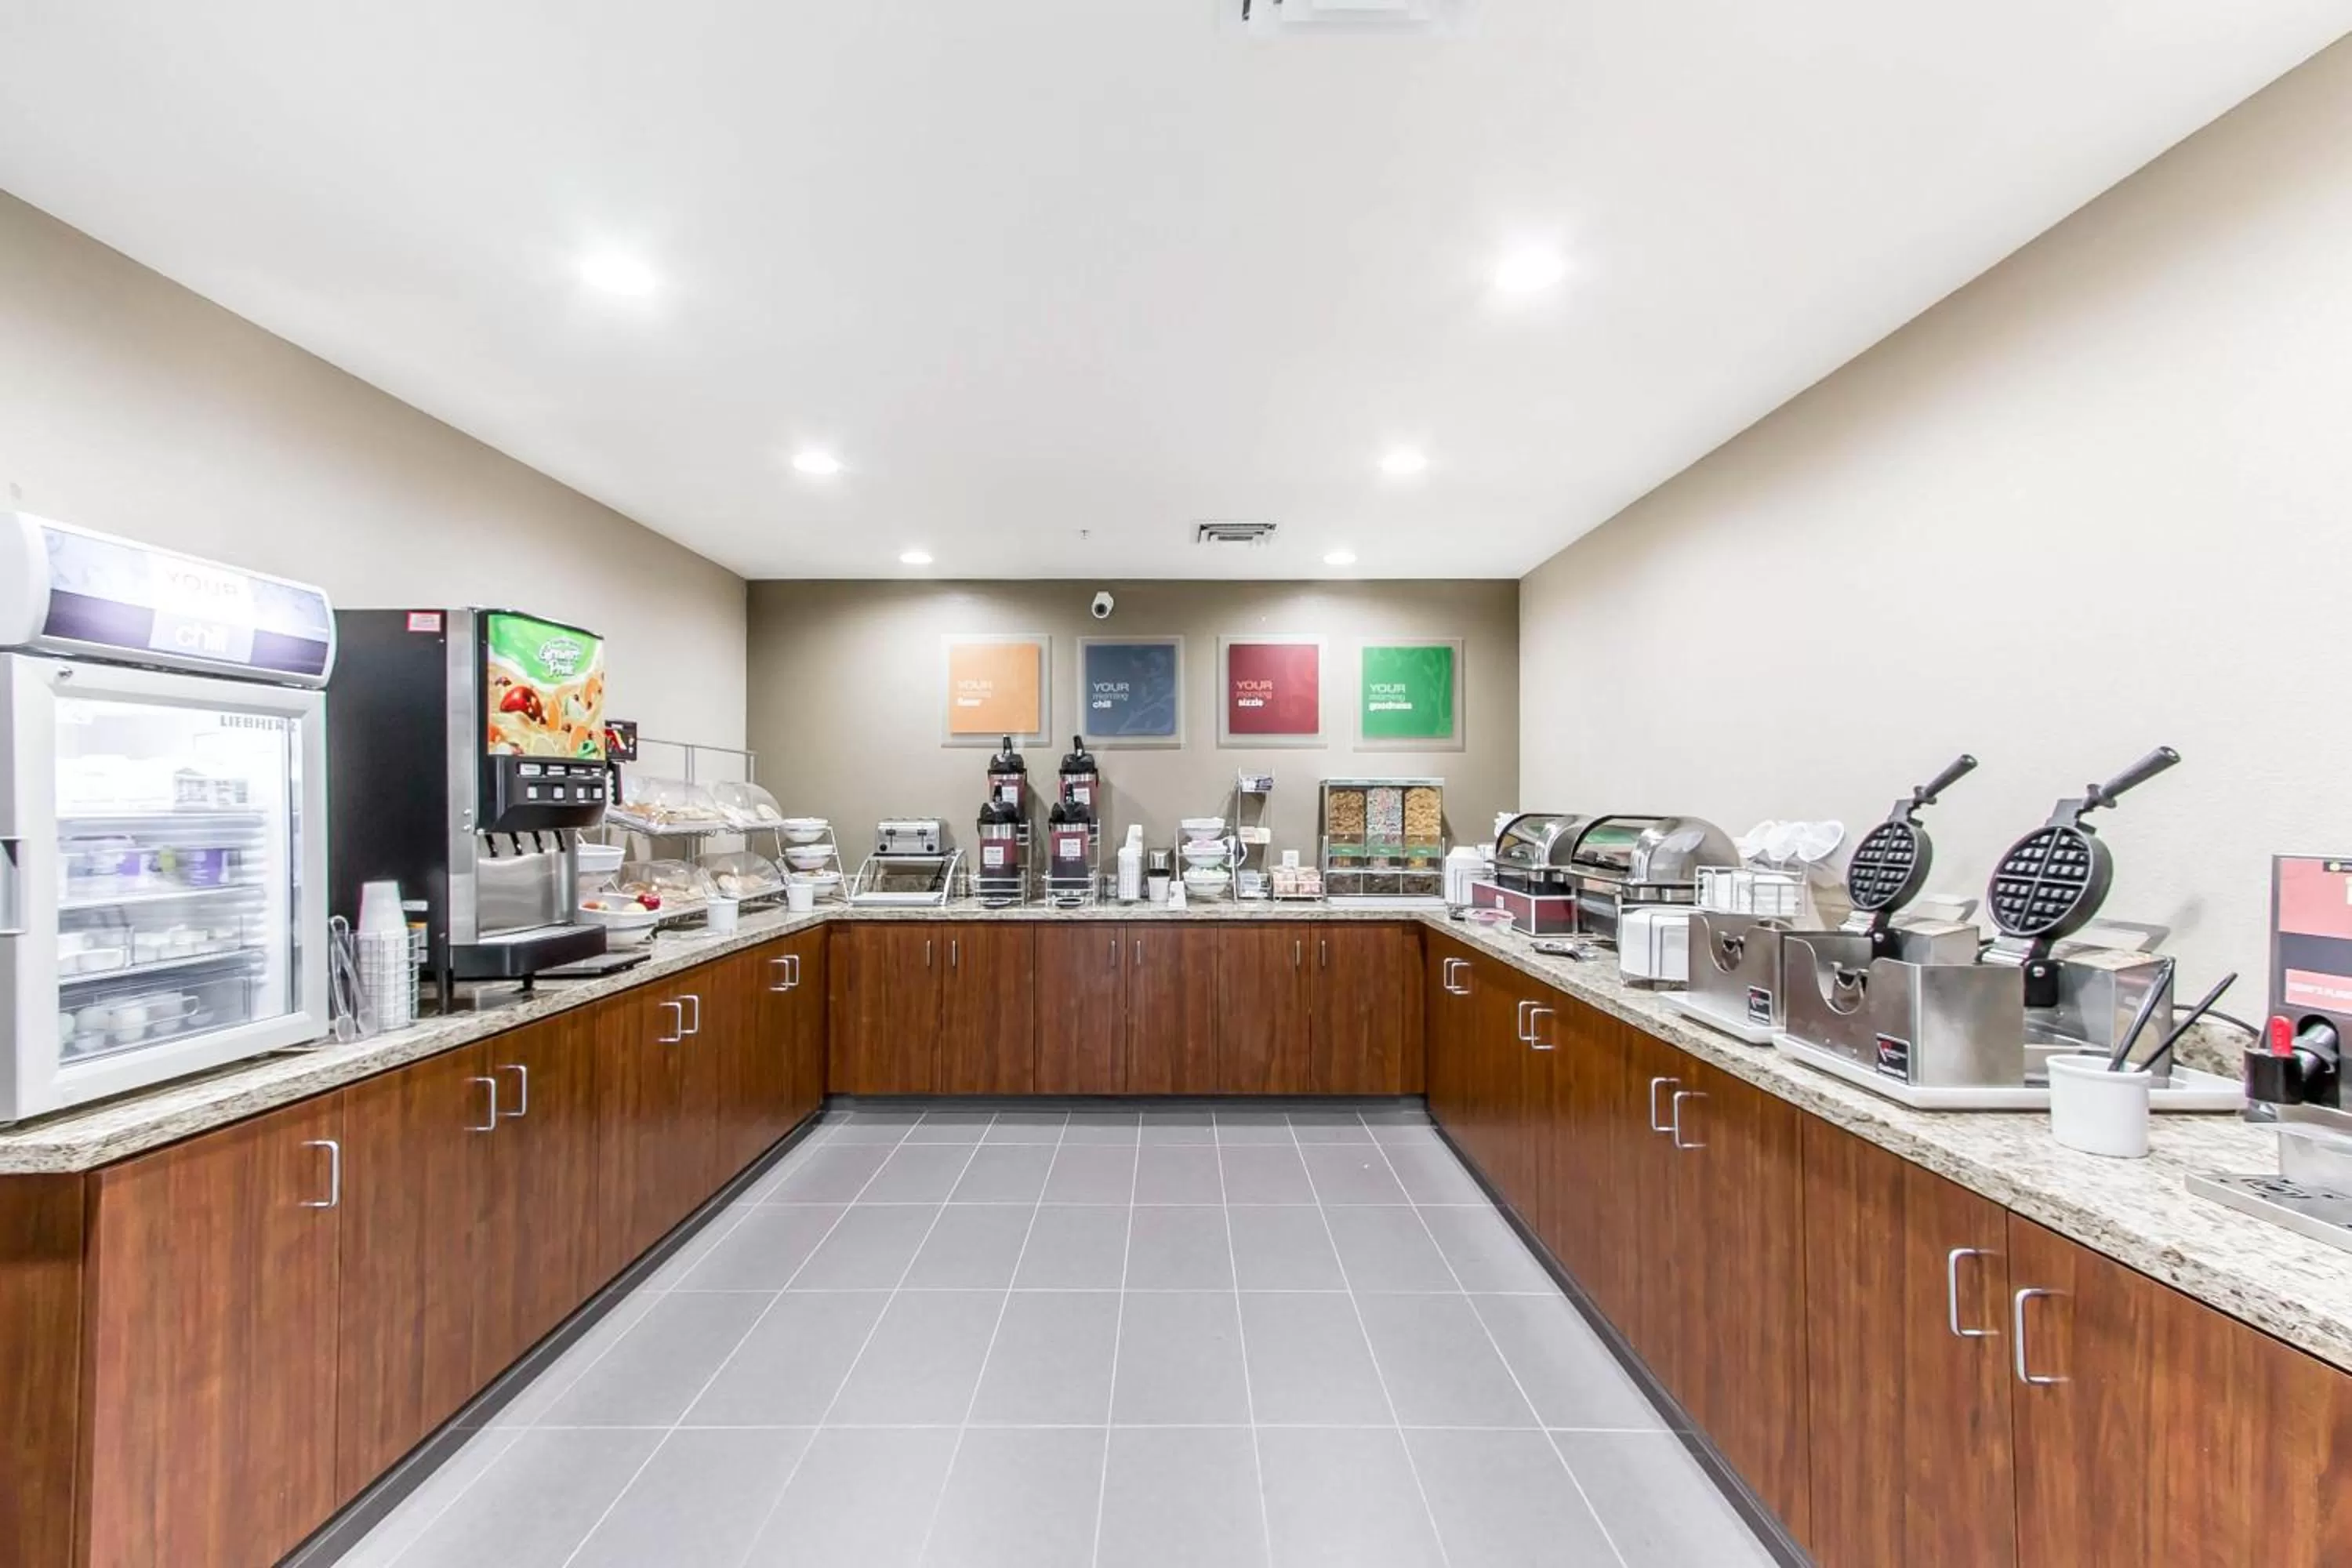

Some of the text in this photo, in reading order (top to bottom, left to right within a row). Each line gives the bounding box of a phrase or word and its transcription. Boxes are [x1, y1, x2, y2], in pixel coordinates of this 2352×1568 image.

[1093, 682, 1129, 692] YOUR
[1236, 680, 1272, 691] YOUR
[1369, 684, 1406, 694] YOUR
[1092, 700, 1112, 709] chill
